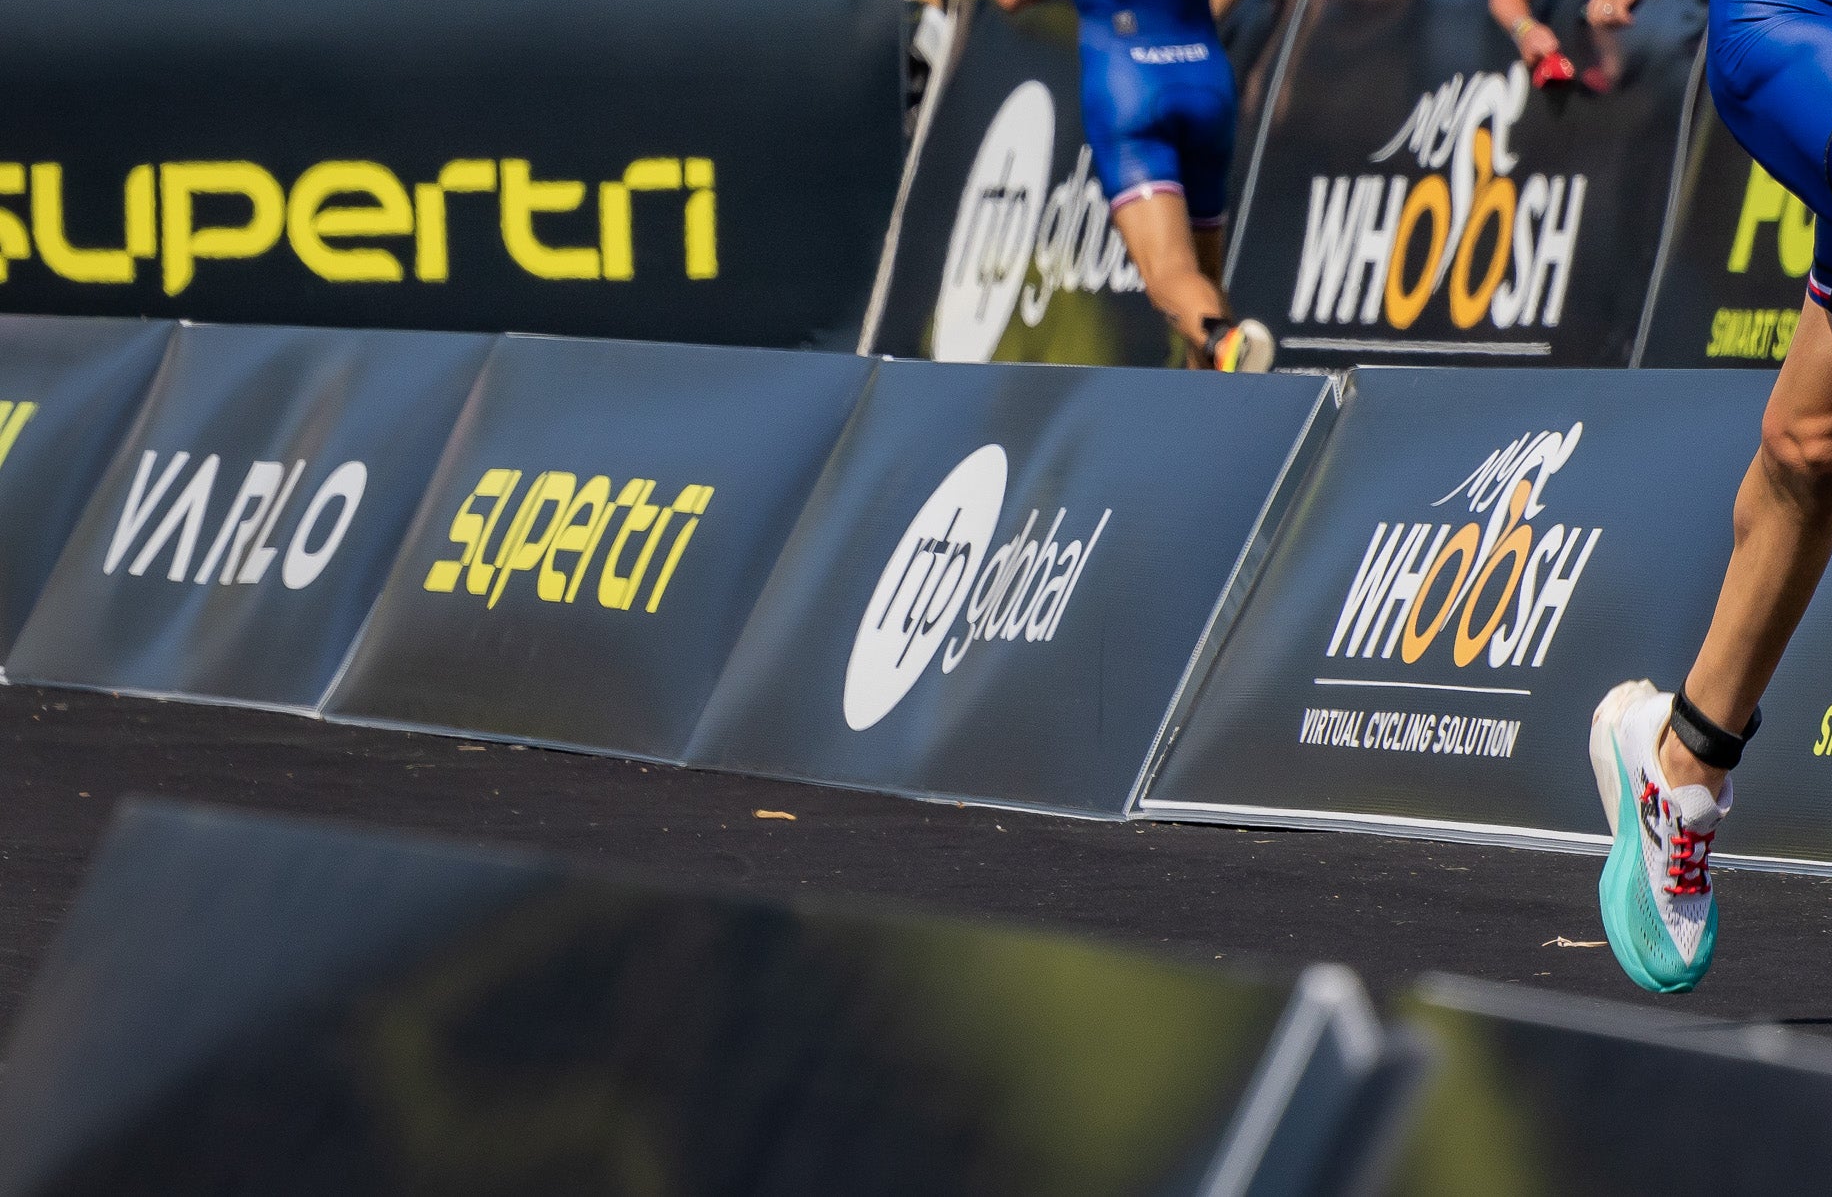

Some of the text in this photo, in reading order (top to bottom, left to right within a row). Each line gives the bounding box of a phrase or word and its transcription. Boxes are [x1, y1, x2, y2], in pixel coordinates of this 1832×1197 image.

[1289, 172, 1589, 330] WHOOSH
[103, 448, 368, 591] VARLO
[942, 507, 1113, 675] global
[1326, 522, 1603, 669] WHOOSH
[1299, 707, 1521, 758] VIRTUAL CYCLING SOLUTION
